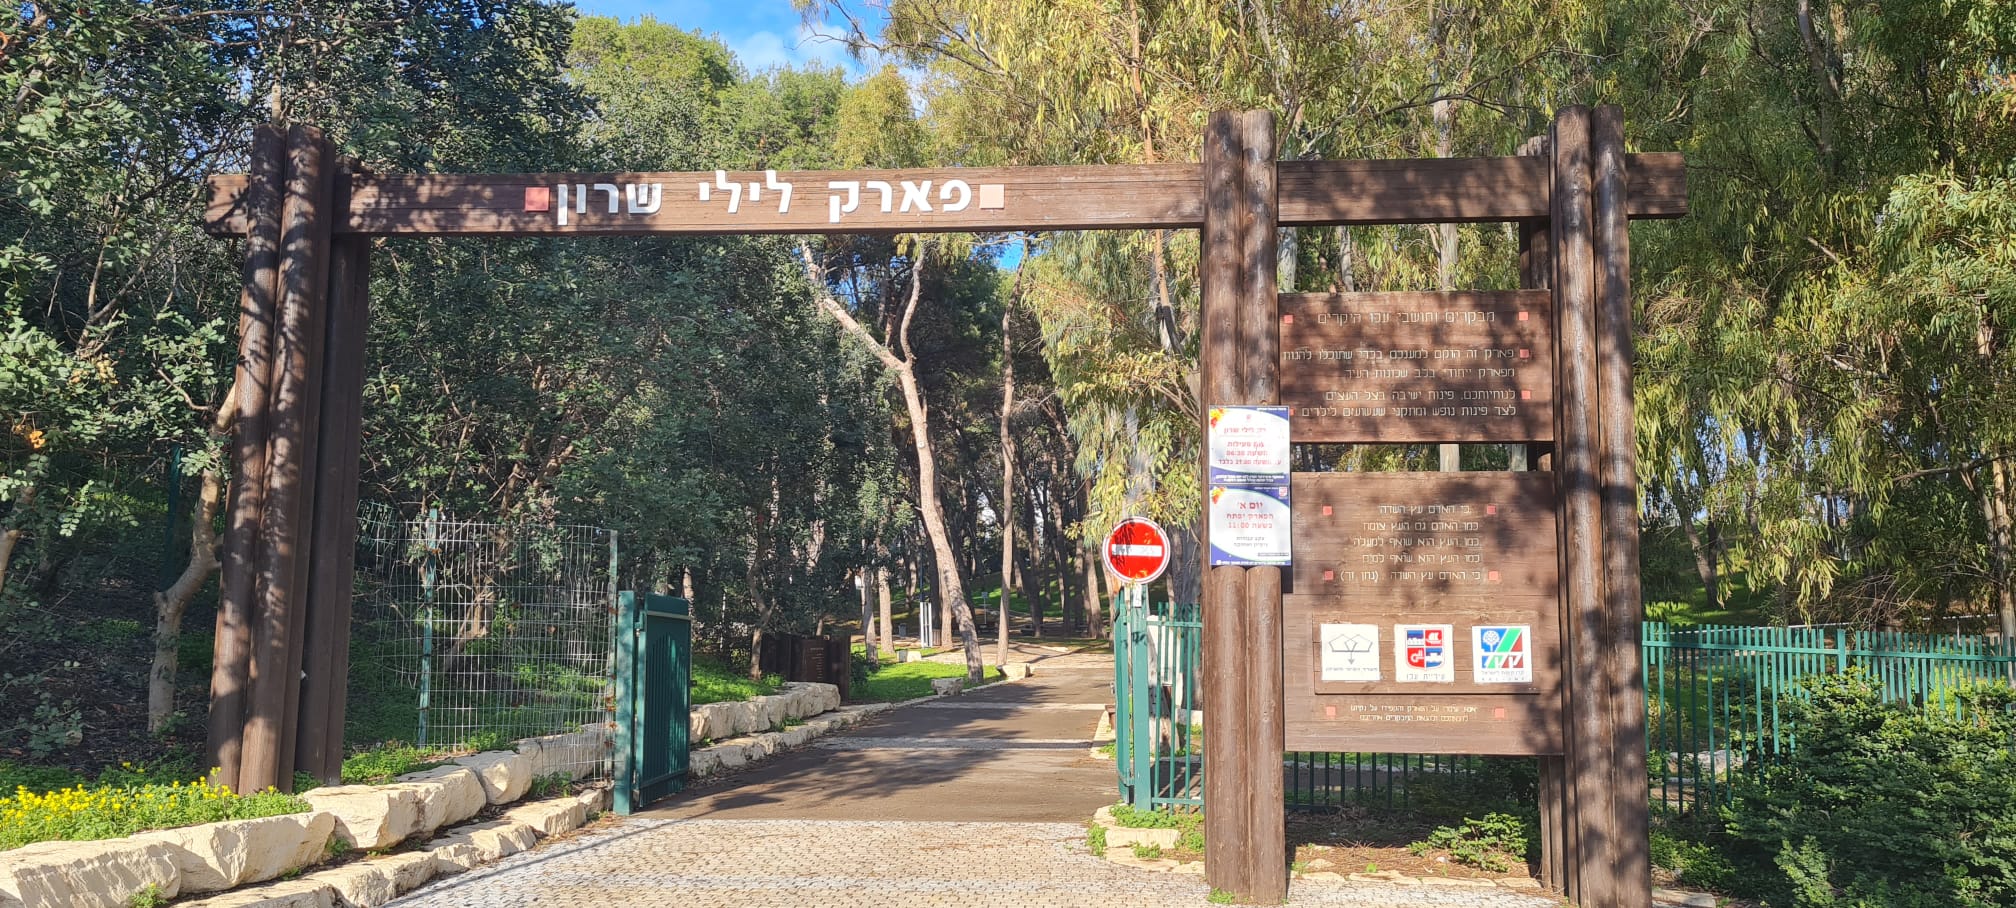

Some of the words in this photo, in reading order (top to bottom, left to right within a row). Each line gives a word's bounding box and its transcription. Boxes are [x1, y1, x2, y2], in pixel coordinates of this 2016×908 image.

[699, 170, 793, 214] לילי
[557, 183, 662, 226] שרון
[828, 179, 972, 223] פארק
[1317, 313, 1361, 326] היקרים
[1369, 312, 1390, 323] עכו
[1397, 312, 1438, 323] ותושבי
[1445, 311, 1495, 325] מבקרים
[1356, 350, 1383, 360] בכדי
[1389, 348, 1428, 360] למענכם
[1434, 349, 1460, 360] הוקם
[1466, 349, 1478, 359] זה
[1484, 349, 1515, 360] פארק
[1345, 369, 1369, 379] העיר
[1375, 368, 1408, 379] שכונות
[1443, 368, 1472, 378] ייחודי
[1478, 368, 1515, 379] מפארק
[1325, 391, 1359, 401] העצים
[1363, 391, 1386, 401] בצל
[1392, 390, 1422, 400] ישיבה
[1428, 390, 1455, 400] פינות
[1301, 405, 1337, 417] לילדים
[1391, 407, 1427, 418] ומתקני
[1432, 406, 1456, 416] נופש
[1461, 406, 1488, 416] פינות
[1493, 404, 1517, 416] לצד
[1249, 501, 1263, 510] יום
[1378, 505, 1407, 514] השדה
[1410, 505, 1423, 516] עץ
[1428, 505, 1455, 514] האדם
[1247, 513, 1273, 521] הפארק
[1363, 522, 1386, 531] צומח
[1391, 522, 1410, 532] העץ
[1414, 522, 1426, 531] גם
[1431, 522, 1458, 531] האדם
[1463, 522, 1479, 531] כמו
[1353, 536, 1384, 547] למעלה
[1389, 537, 1413, 548] שואף
[1417, 537, 1435, 547] הוא
[1440, 537, 1459, 549] העץ
[1464, 537, 1480, 547] כמו
[1418, 554, 1435, 563] הוא
[1440, 554, 1460, 565] העץ
[1464, 554, 1480, 563] כמו
[1390, 571, 1416, 580] השדה
[1420, 571, 1434, 582] עץ
[1439, 571, 1466, 580] האדם
[1471, 571, 1481, 580] כי
